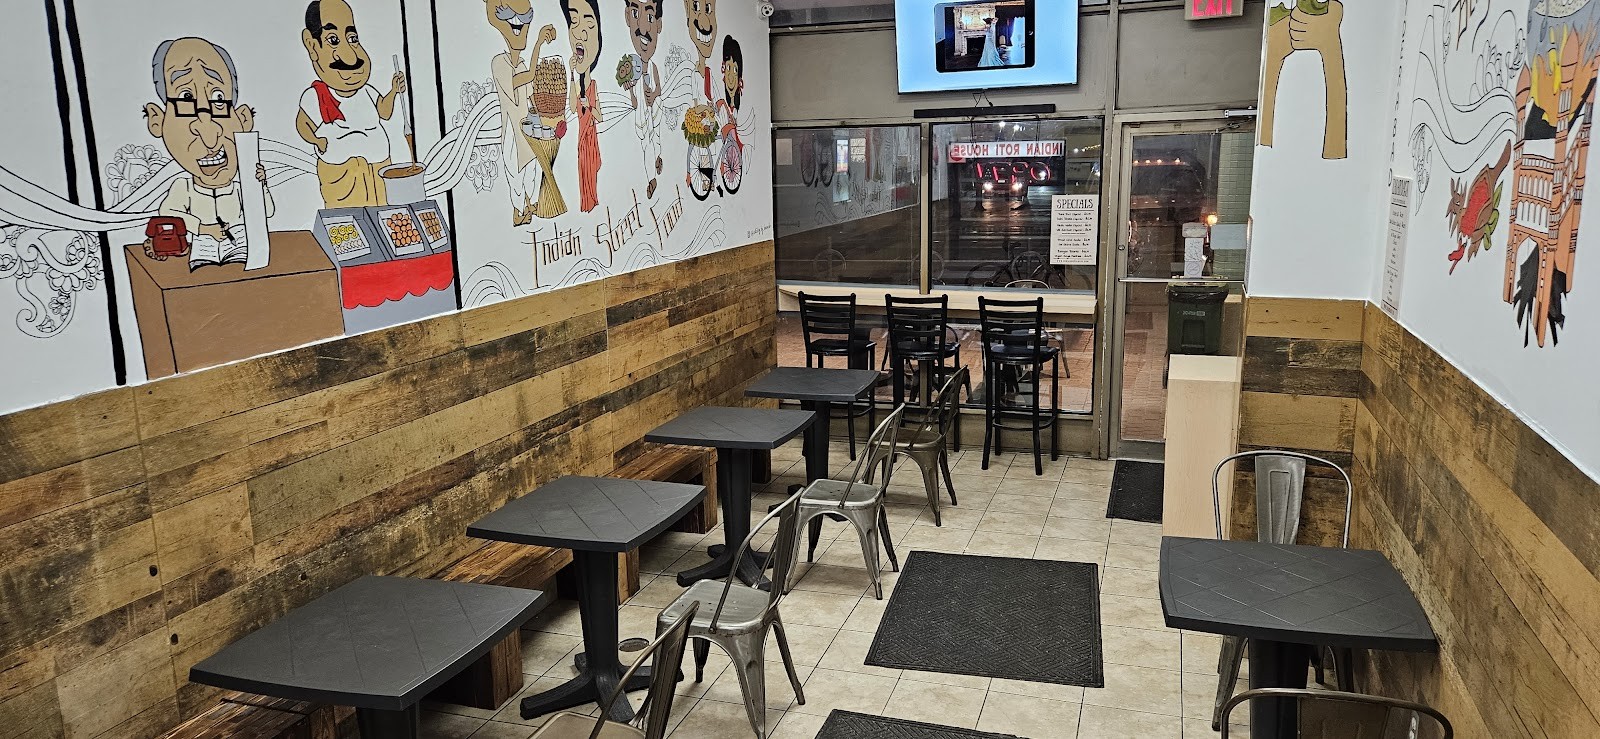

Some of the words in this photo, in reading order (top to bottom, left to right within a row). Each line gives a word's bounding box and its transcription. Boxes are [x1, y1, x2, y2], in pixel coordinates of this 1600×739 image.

[1056, 198, 1094, 209] SPECIALS
[521, 222, 582, 290] Indian
[592, 188, 644, 268] Street
[646, 184, 685, 250] Food
